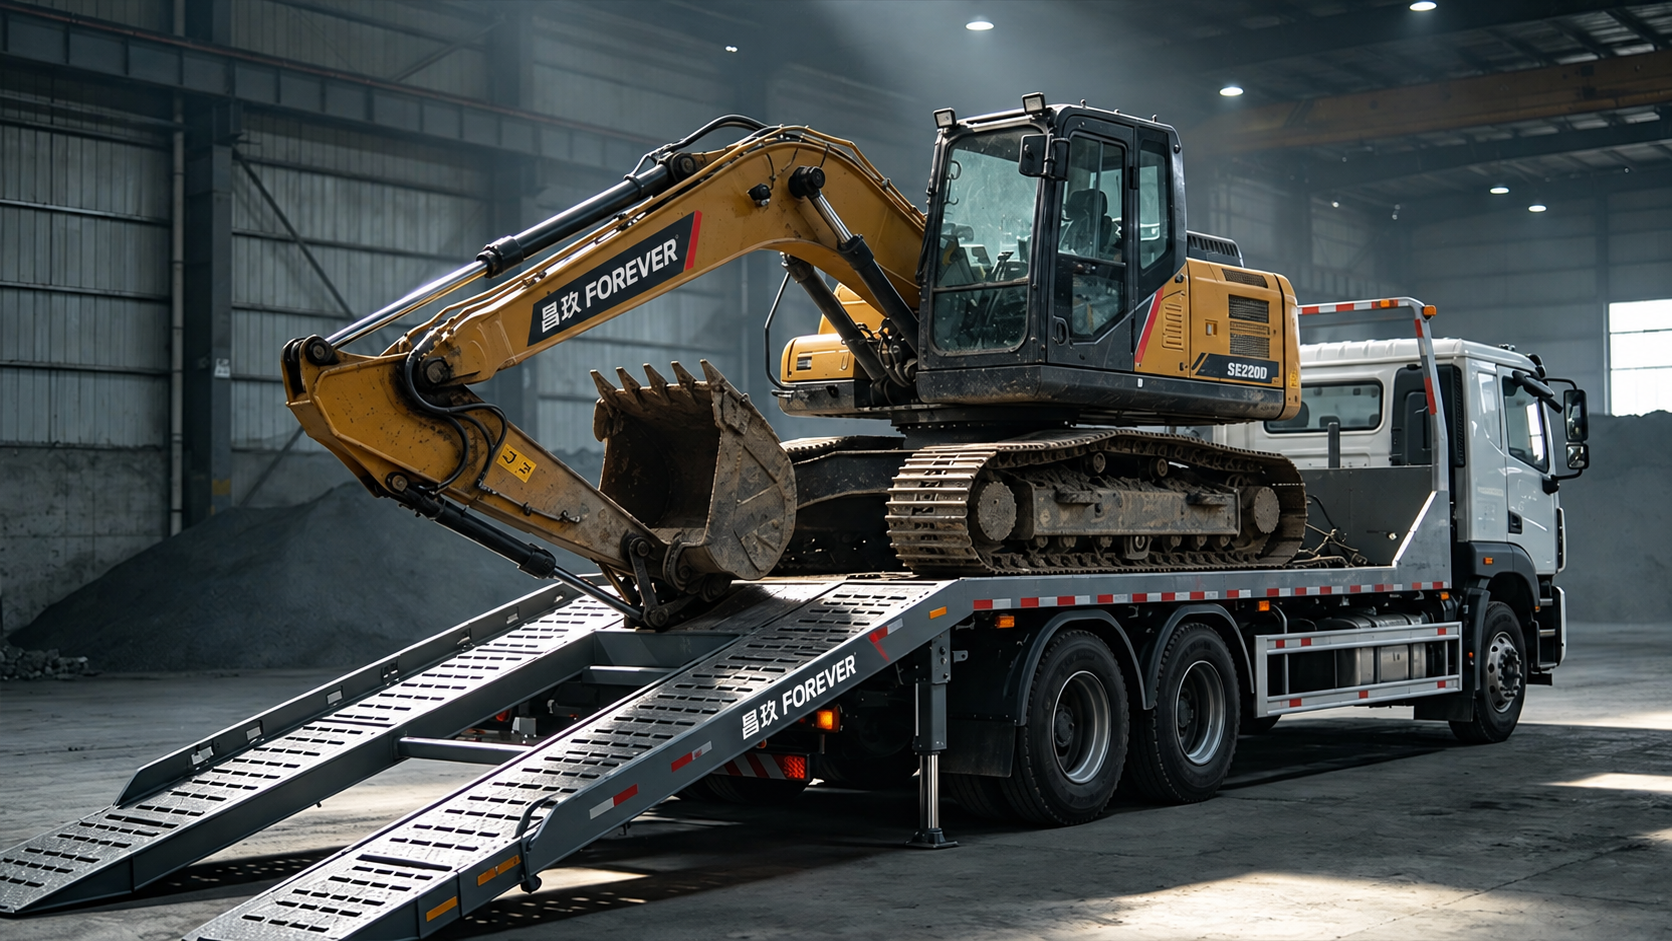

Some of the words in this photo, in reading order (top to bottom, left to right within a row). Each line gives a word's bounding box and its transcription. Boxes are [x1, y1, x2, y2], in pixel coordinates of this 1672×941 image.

[541, 291, 582, 333] 昌玖
[585, 238, 678, 308] FOREVER
[1227, 362, 1268, 379] SE220D
[742, 700, 779, 740] 昌玖
[782, 654, 856, 715] FOREVER
